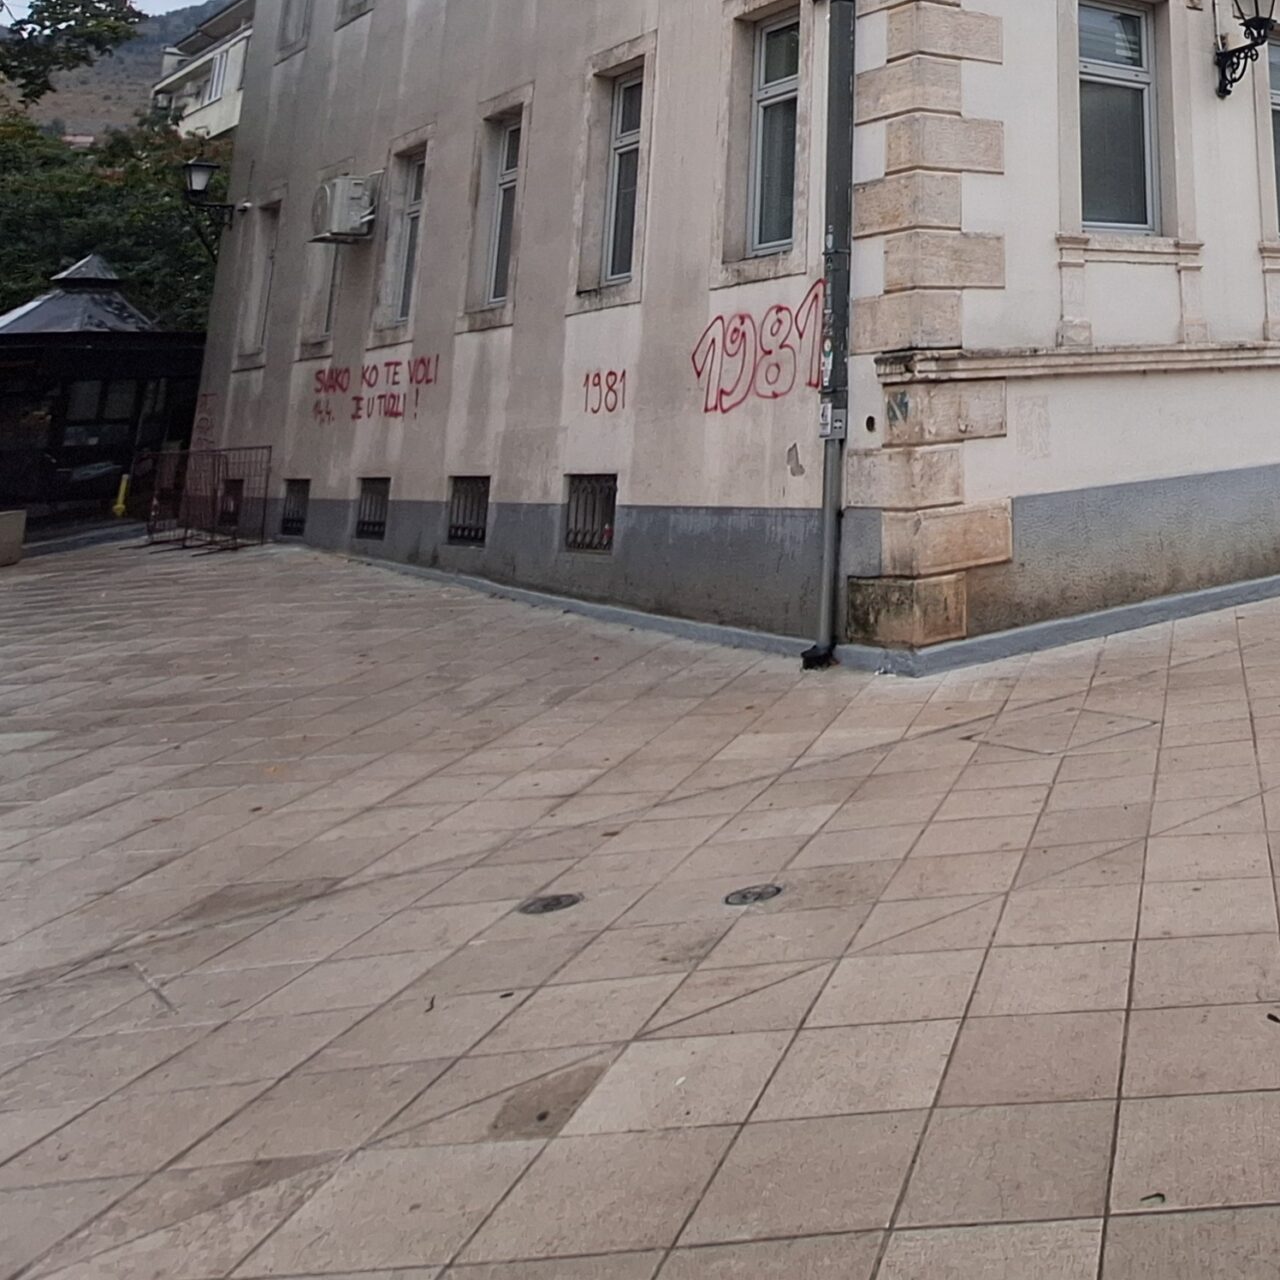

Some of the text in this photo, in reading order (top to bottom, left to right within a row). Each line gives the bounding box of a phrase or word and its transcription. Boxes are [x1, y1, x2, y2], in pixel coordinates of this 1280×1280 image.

[692, 278, 827, 413] 1981
[361, 364, 379, 388] KO
[384, 361, 402, 386] TE
[408, 353, 440, 386] VOLI
[367, 395, 375, 419] U
[583, 369, 626, 414] 1981
